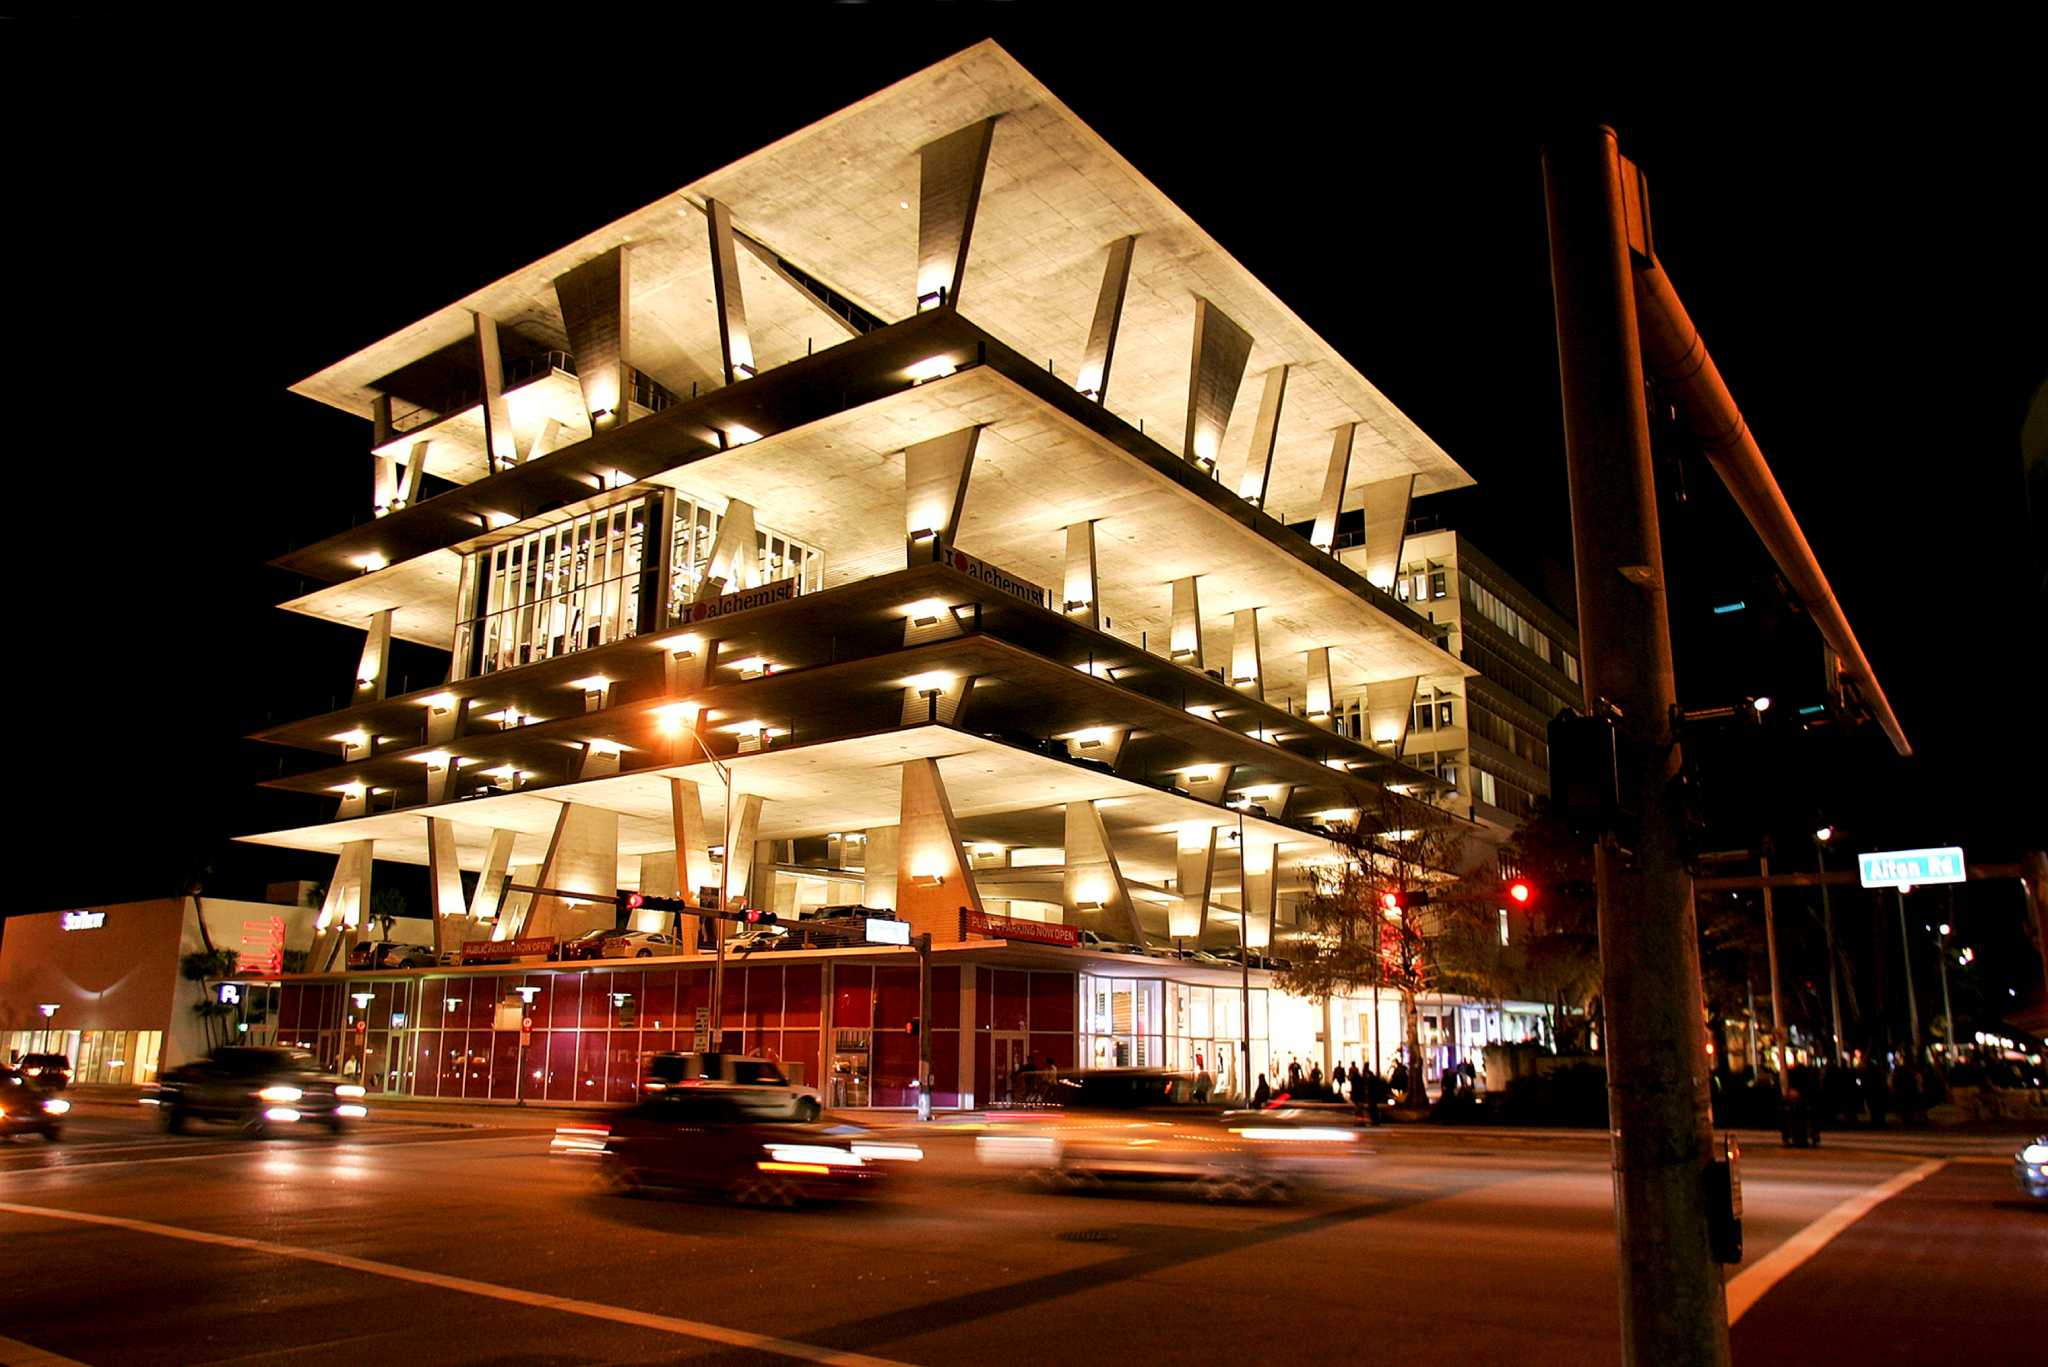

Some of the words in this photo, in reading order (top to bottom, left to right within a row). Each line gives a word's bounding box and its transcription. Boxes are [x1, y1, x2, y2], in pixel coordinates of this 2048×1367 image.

[969, 562, 1044, 608] alchemist
[707, 584, 793, 618] alchemist
[1871, 858, 1920, 880] Alton
[1927, 855, 1953, 877] Rd
[971, 916, 1001, 932] PUBC
[1036, 927, 1054, 938] NOW
[1054, 928, 1074, 941] OPEN
